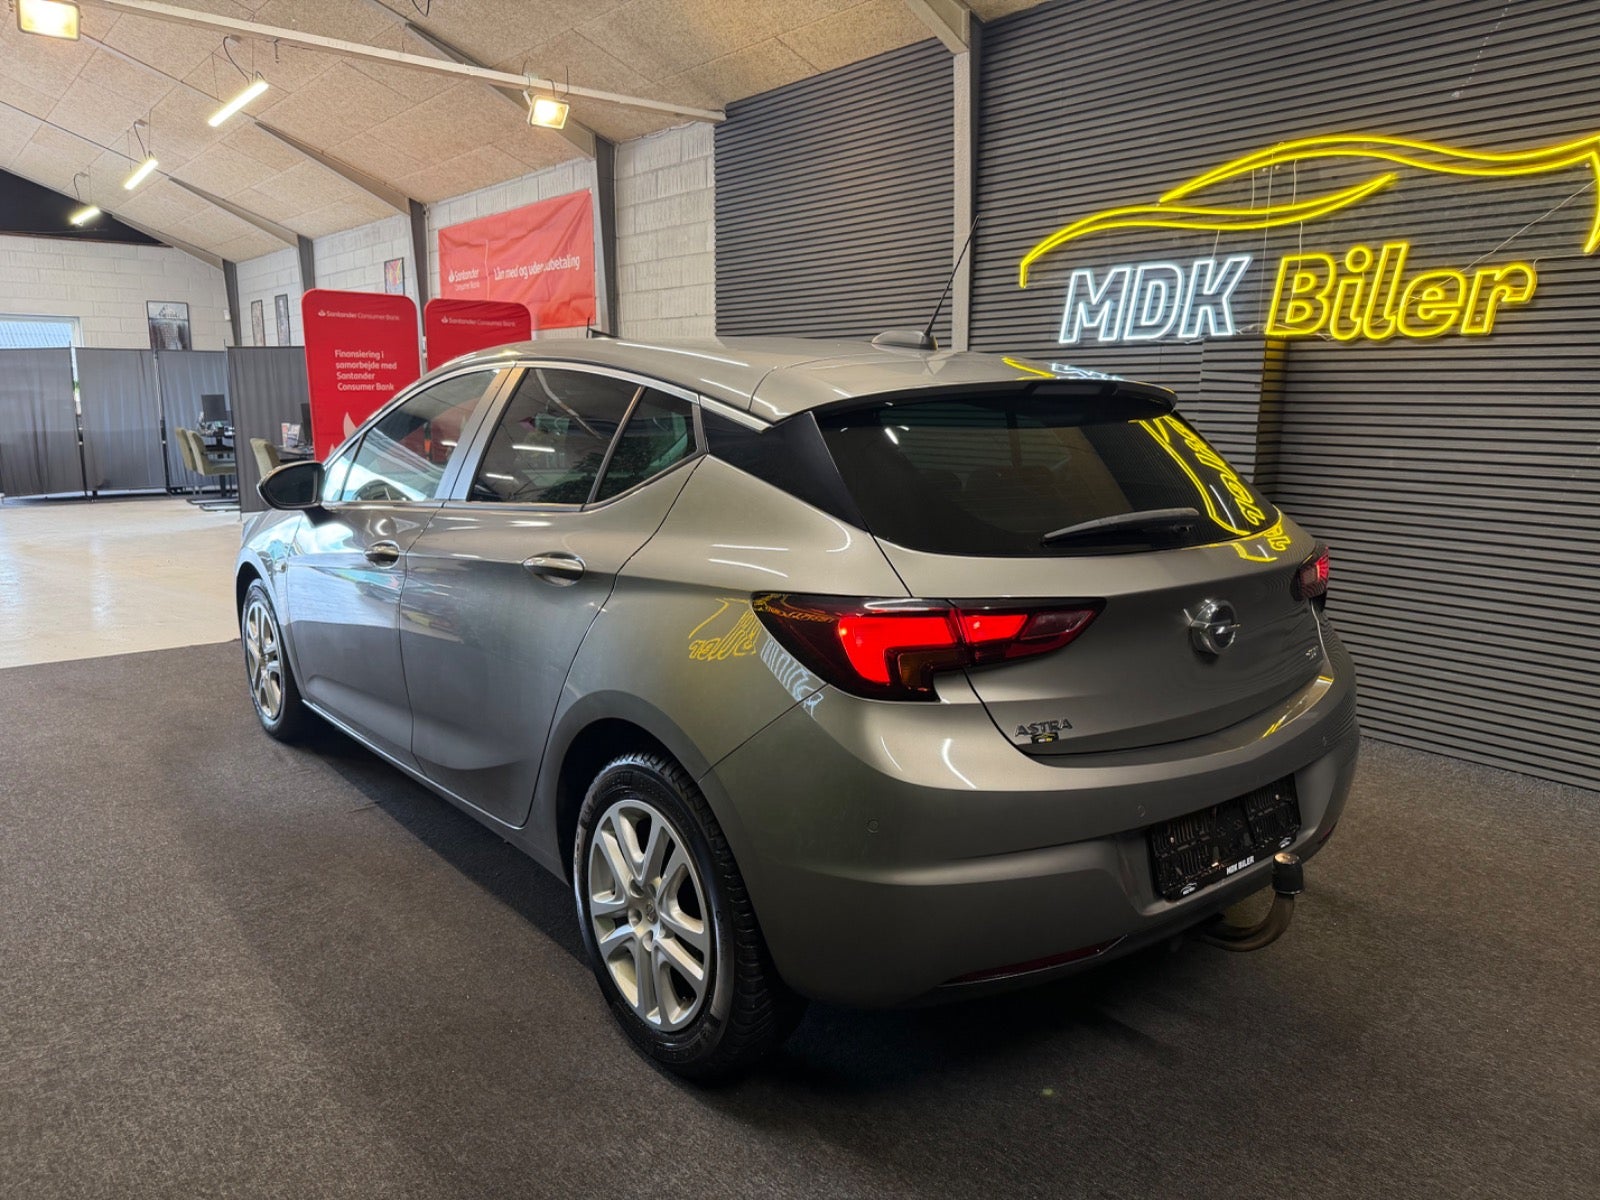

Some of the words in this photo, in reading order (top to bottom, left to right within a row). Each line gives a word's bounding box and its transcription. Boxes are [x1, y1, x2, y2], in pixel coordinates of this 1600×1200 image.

[454, 268, 480, 282] Santander
[519, 266, 529, 279] og
[1058, 254, 1253, 345] MDK
[1264, 241, 1538, 341] Biler
[326, 310, 357, 319] Santander
[357, 313, 386, 321] Consumer
[448, 317, 477, 326] Santander
[334, 349, 381, 361] Finansiering
[335, 361, 380, 371] samarbejde
[380, 362, 397, 370] med
[336, 371, 376, 381] Santander
[337, 382, 375, 392] Consumer
[375, 382, 394, 391] Bank
[1014, 718, 1073, 738] ASTRA
